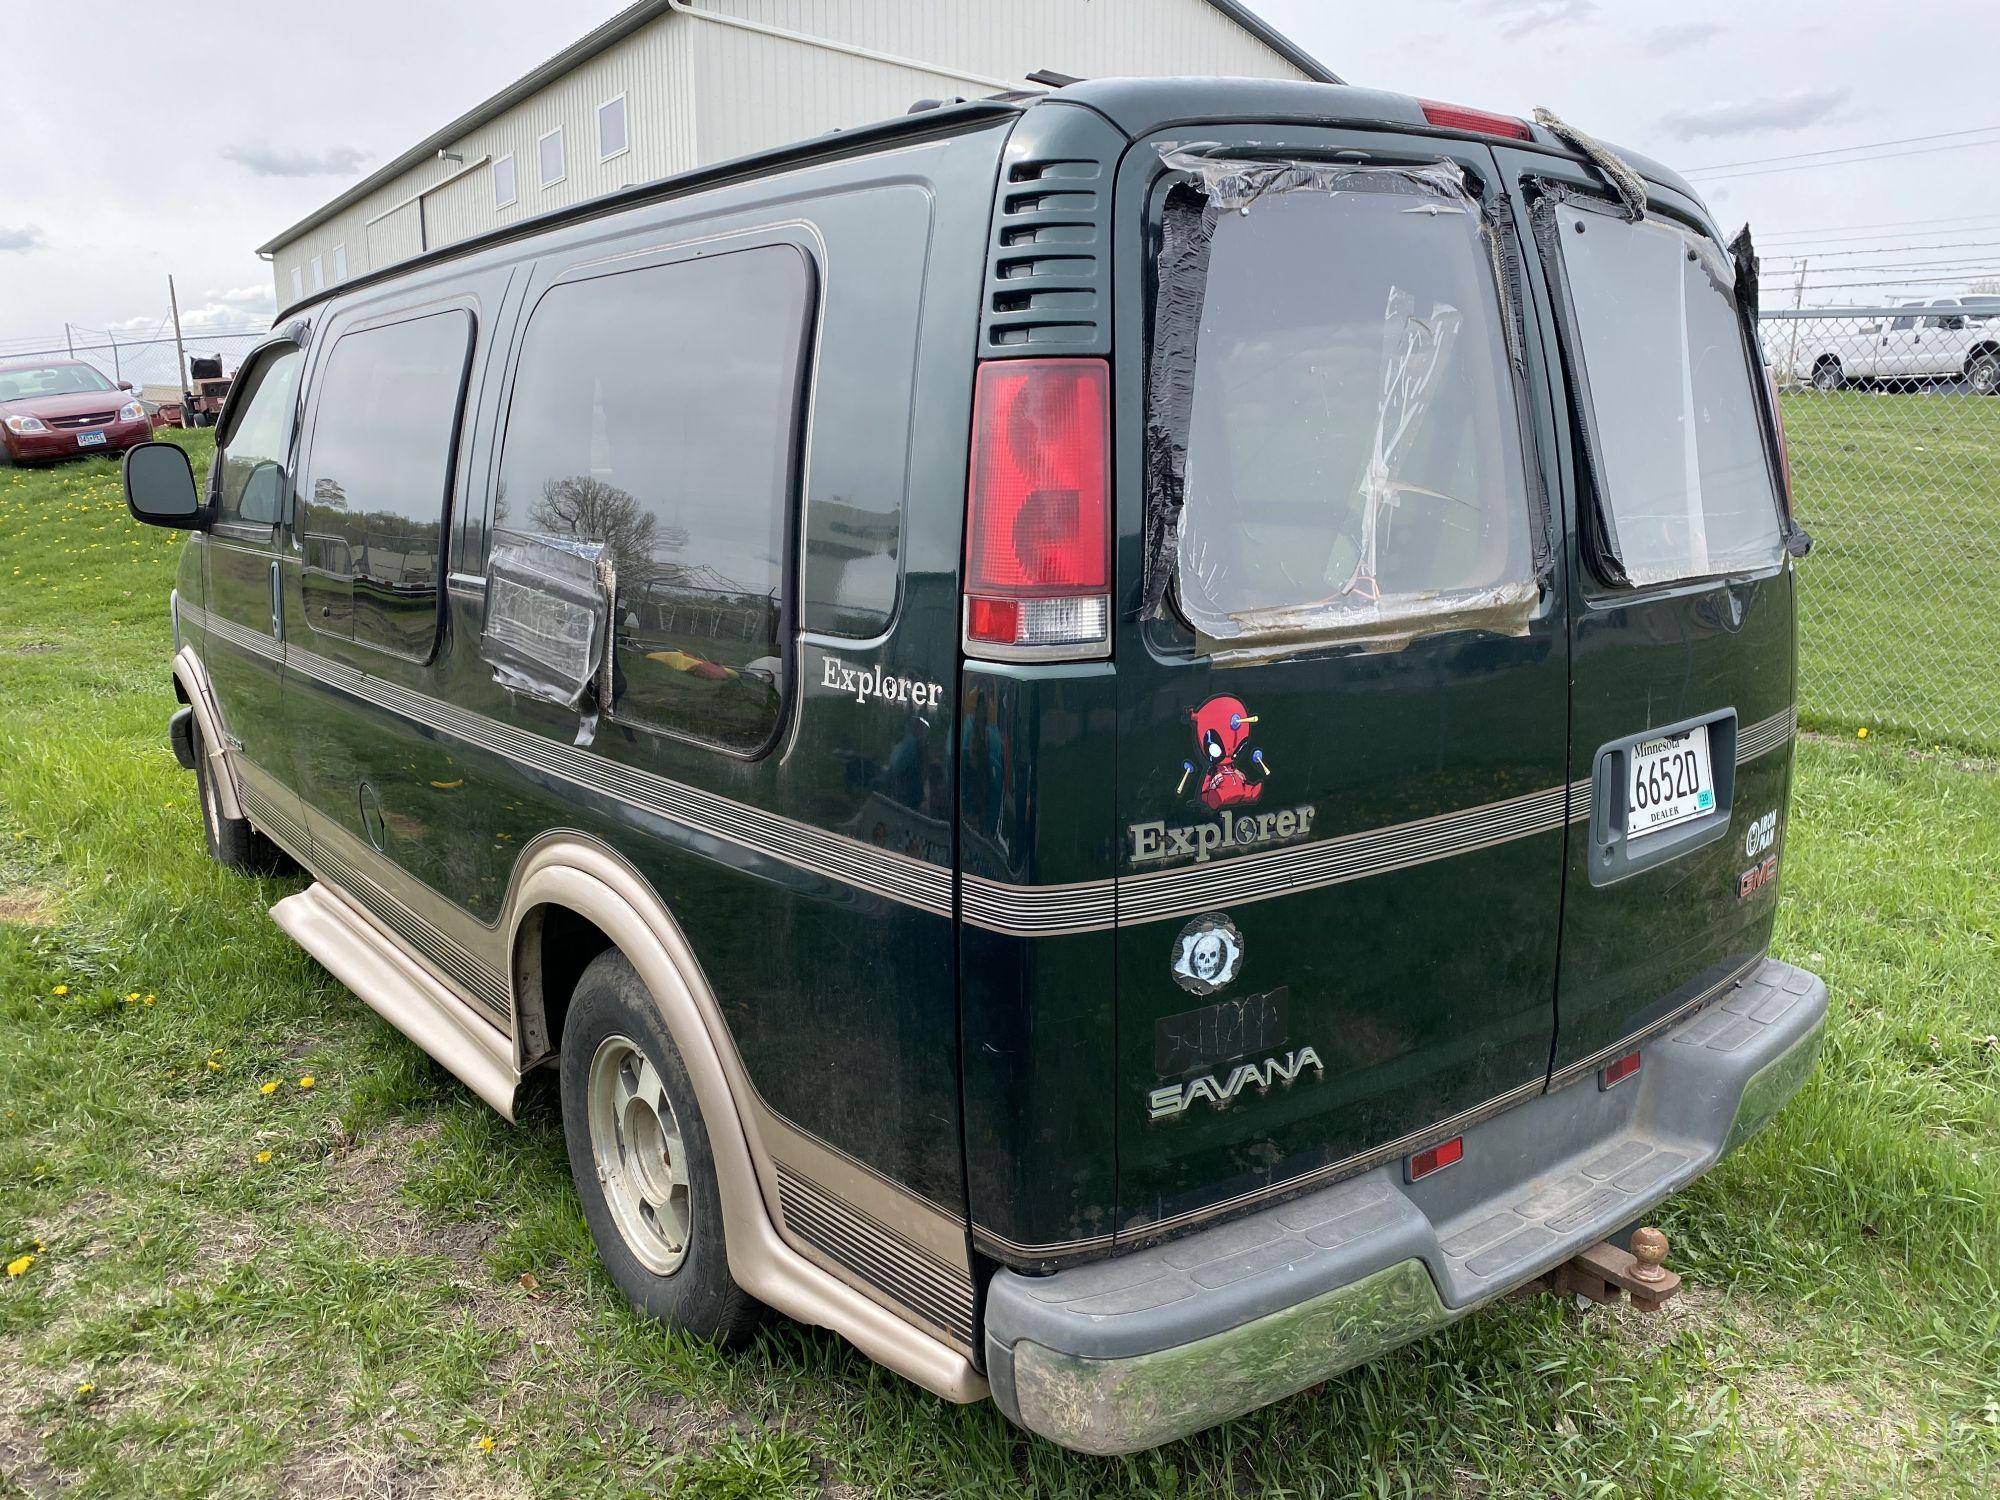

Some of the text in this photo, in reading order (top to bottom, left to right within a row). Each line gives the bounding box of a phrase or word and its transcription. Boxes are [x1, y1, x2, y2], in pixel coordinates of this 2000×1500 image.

[821, 656, 943, 706] Explorer
[1634, 739, 1680, 759] Minnesota
[1630, 750, 1700, 812] 6652D
[1129, 805, 1315, 863] Explorer
[1650, 806, 1680, 822] DEALER
[1760, 809, 1777, 833] IRON
[1739, 856, 1777, 896] GMC
[1148, 1046, 1324, 1118] SAVANA
